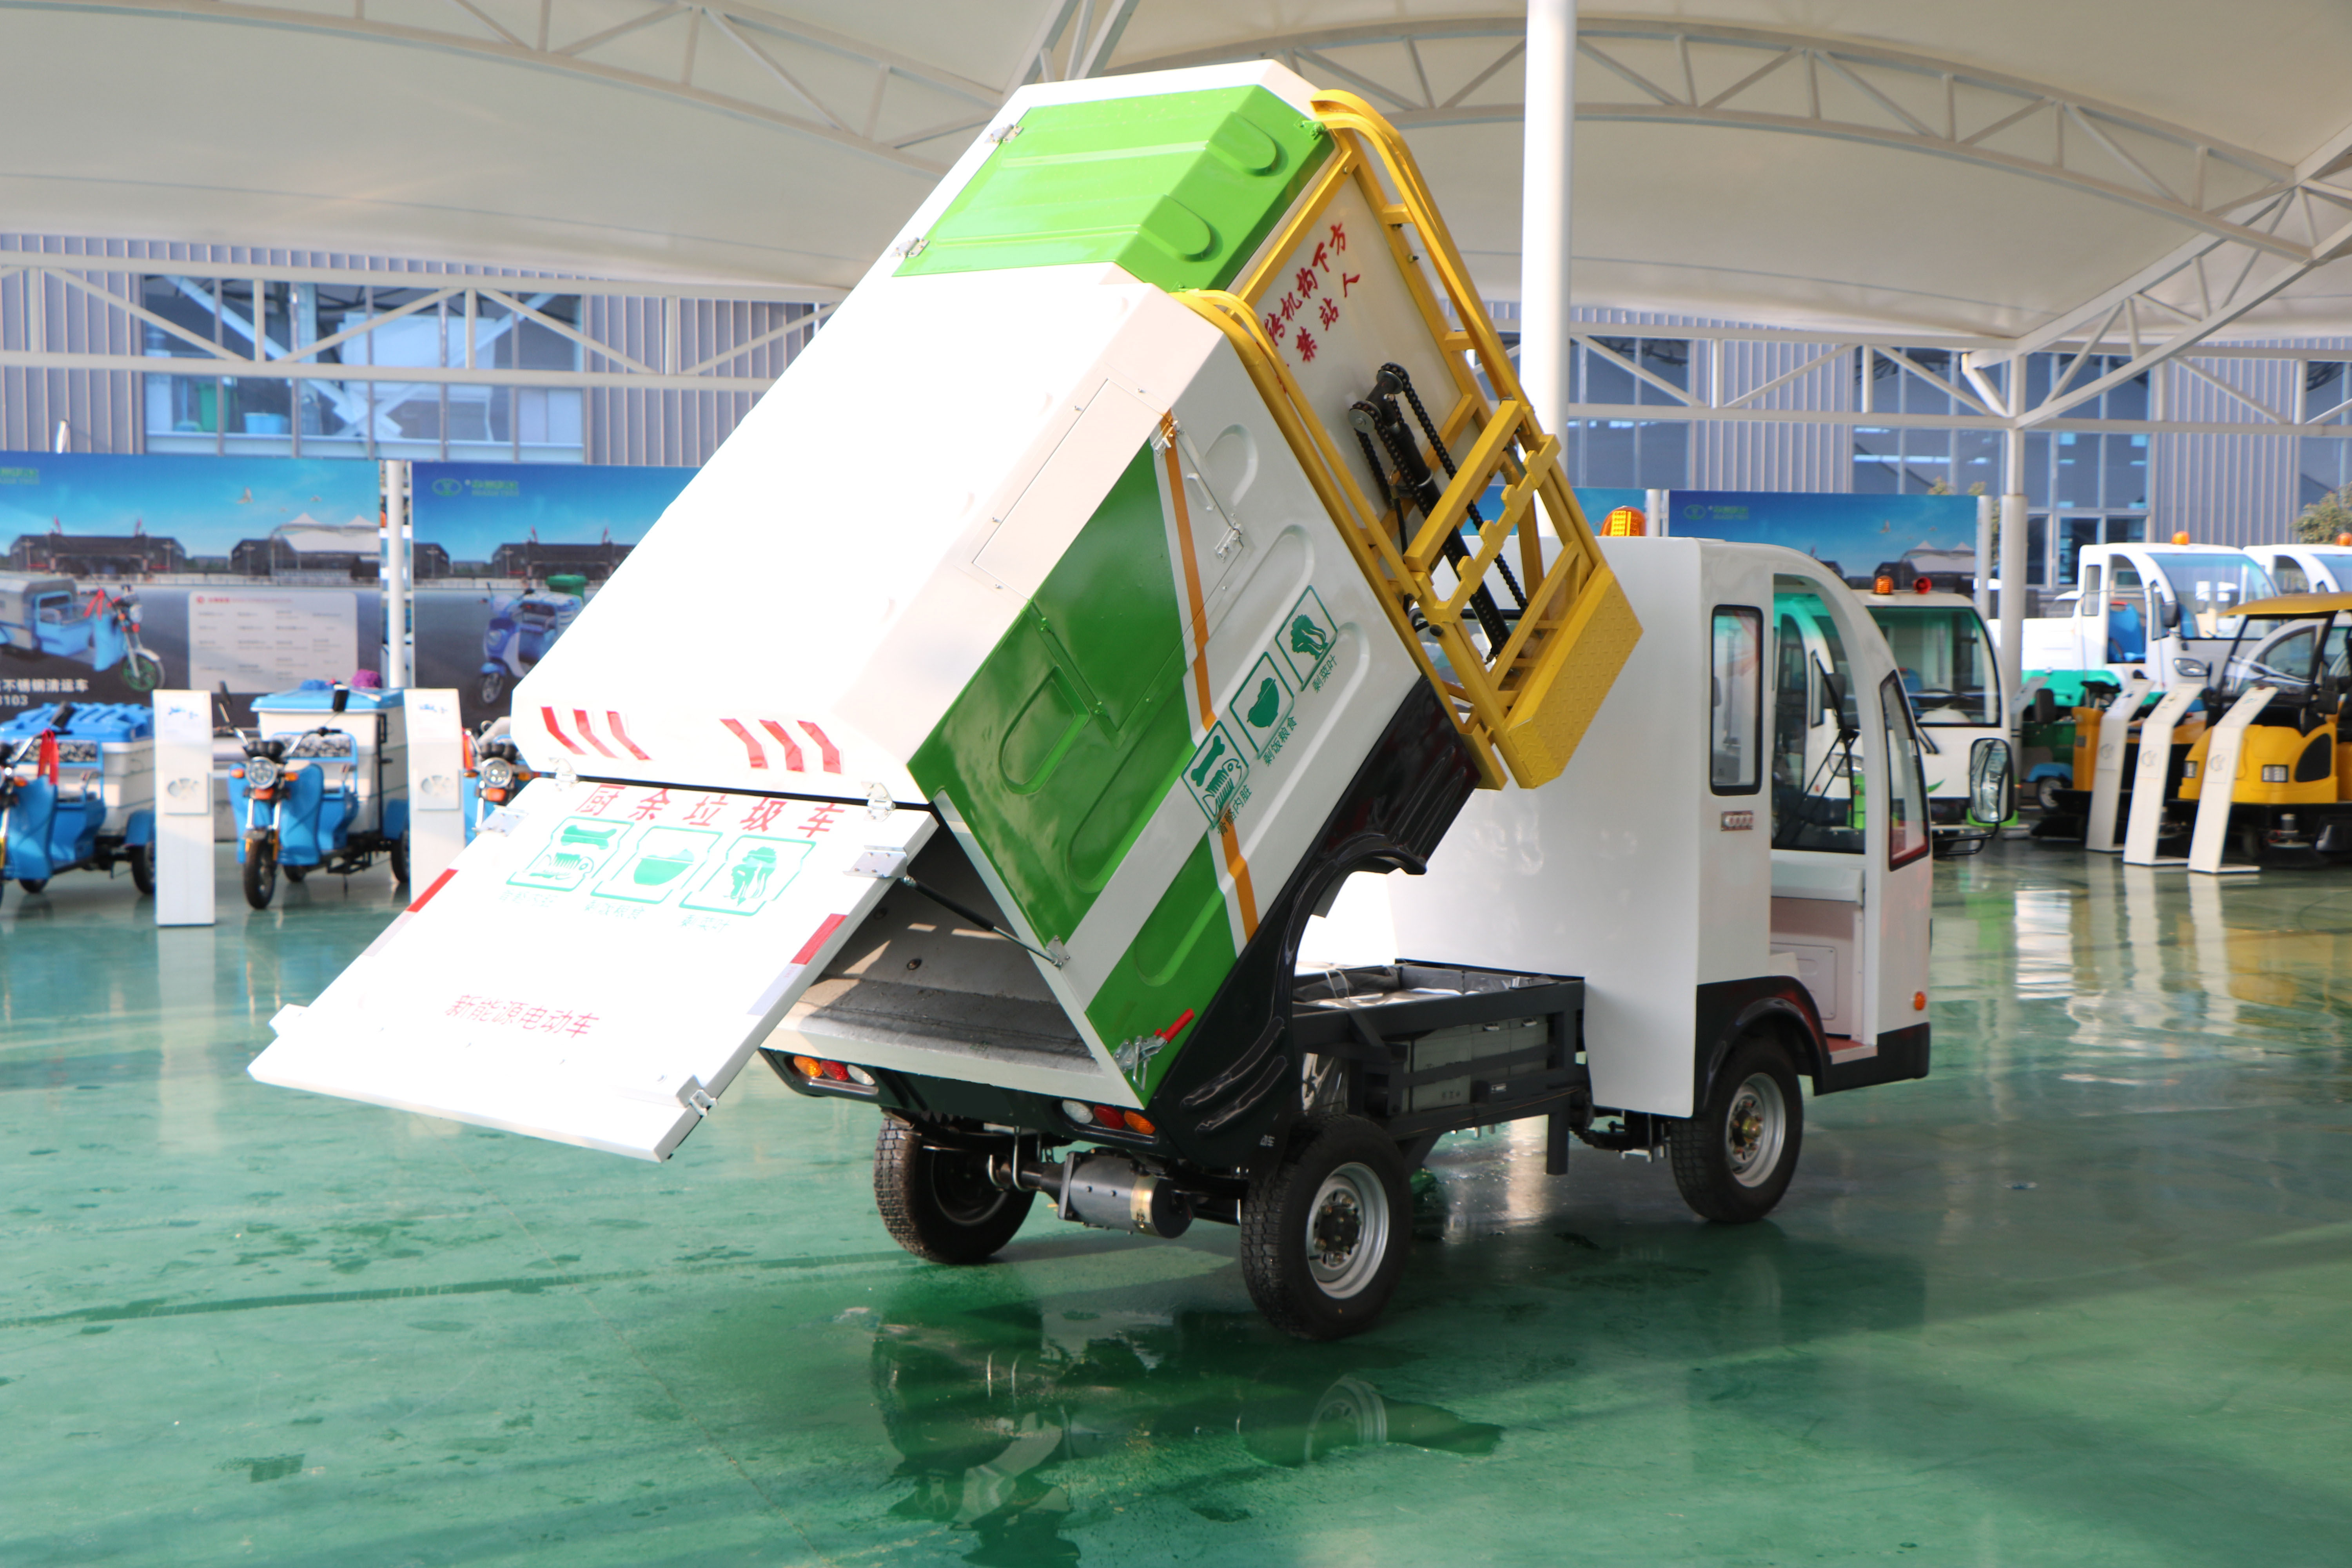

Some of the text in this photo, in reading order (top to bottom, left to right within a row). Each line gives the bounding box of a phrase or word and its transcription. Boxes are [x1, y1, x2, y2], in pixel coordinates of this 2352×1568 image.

[0, 678, 89, 693] 不锈钢清运车
[1312, 654, 1338, 693] 剩菜叶
[1263, 716, 1298, 767] 剩饭粮食
[575, 784, 845, 838] 厨余垃圾车
[445, 994, 600, 1038] 新能源电动车
